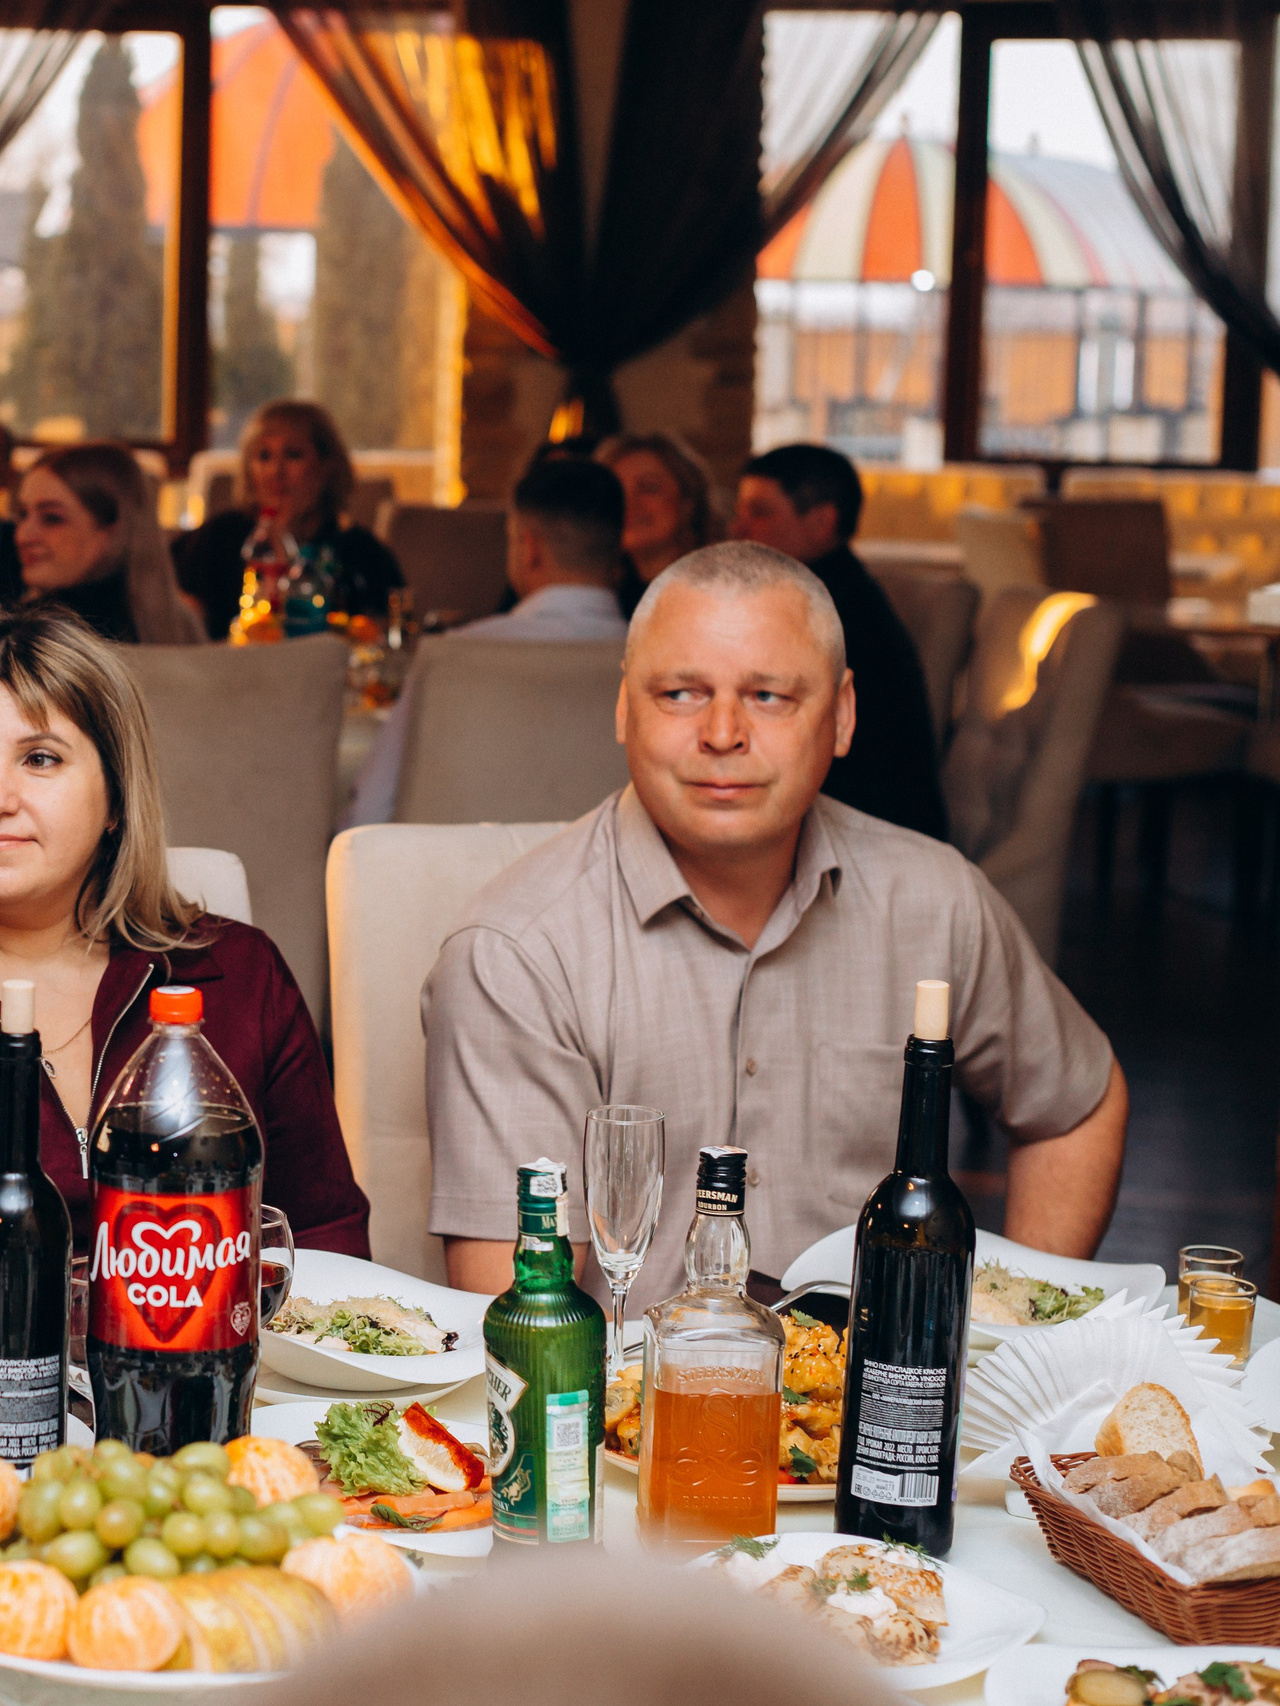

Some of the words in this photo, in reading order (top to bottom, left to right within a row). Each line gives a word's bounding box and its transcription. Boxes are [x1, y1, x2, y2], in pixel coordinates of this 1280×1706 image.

[90, 1220, 250, 1282] Любимая
[127, 1283, 203, 1307] COLA
[677, 1366, 766, 1386] STEERSMAN
[863, 1359, 878, 1369] ВИНО
[923, 1367, 947, 1375] КРАСНОЕ
[897, 1444, 913, 1453] МЕСТО
